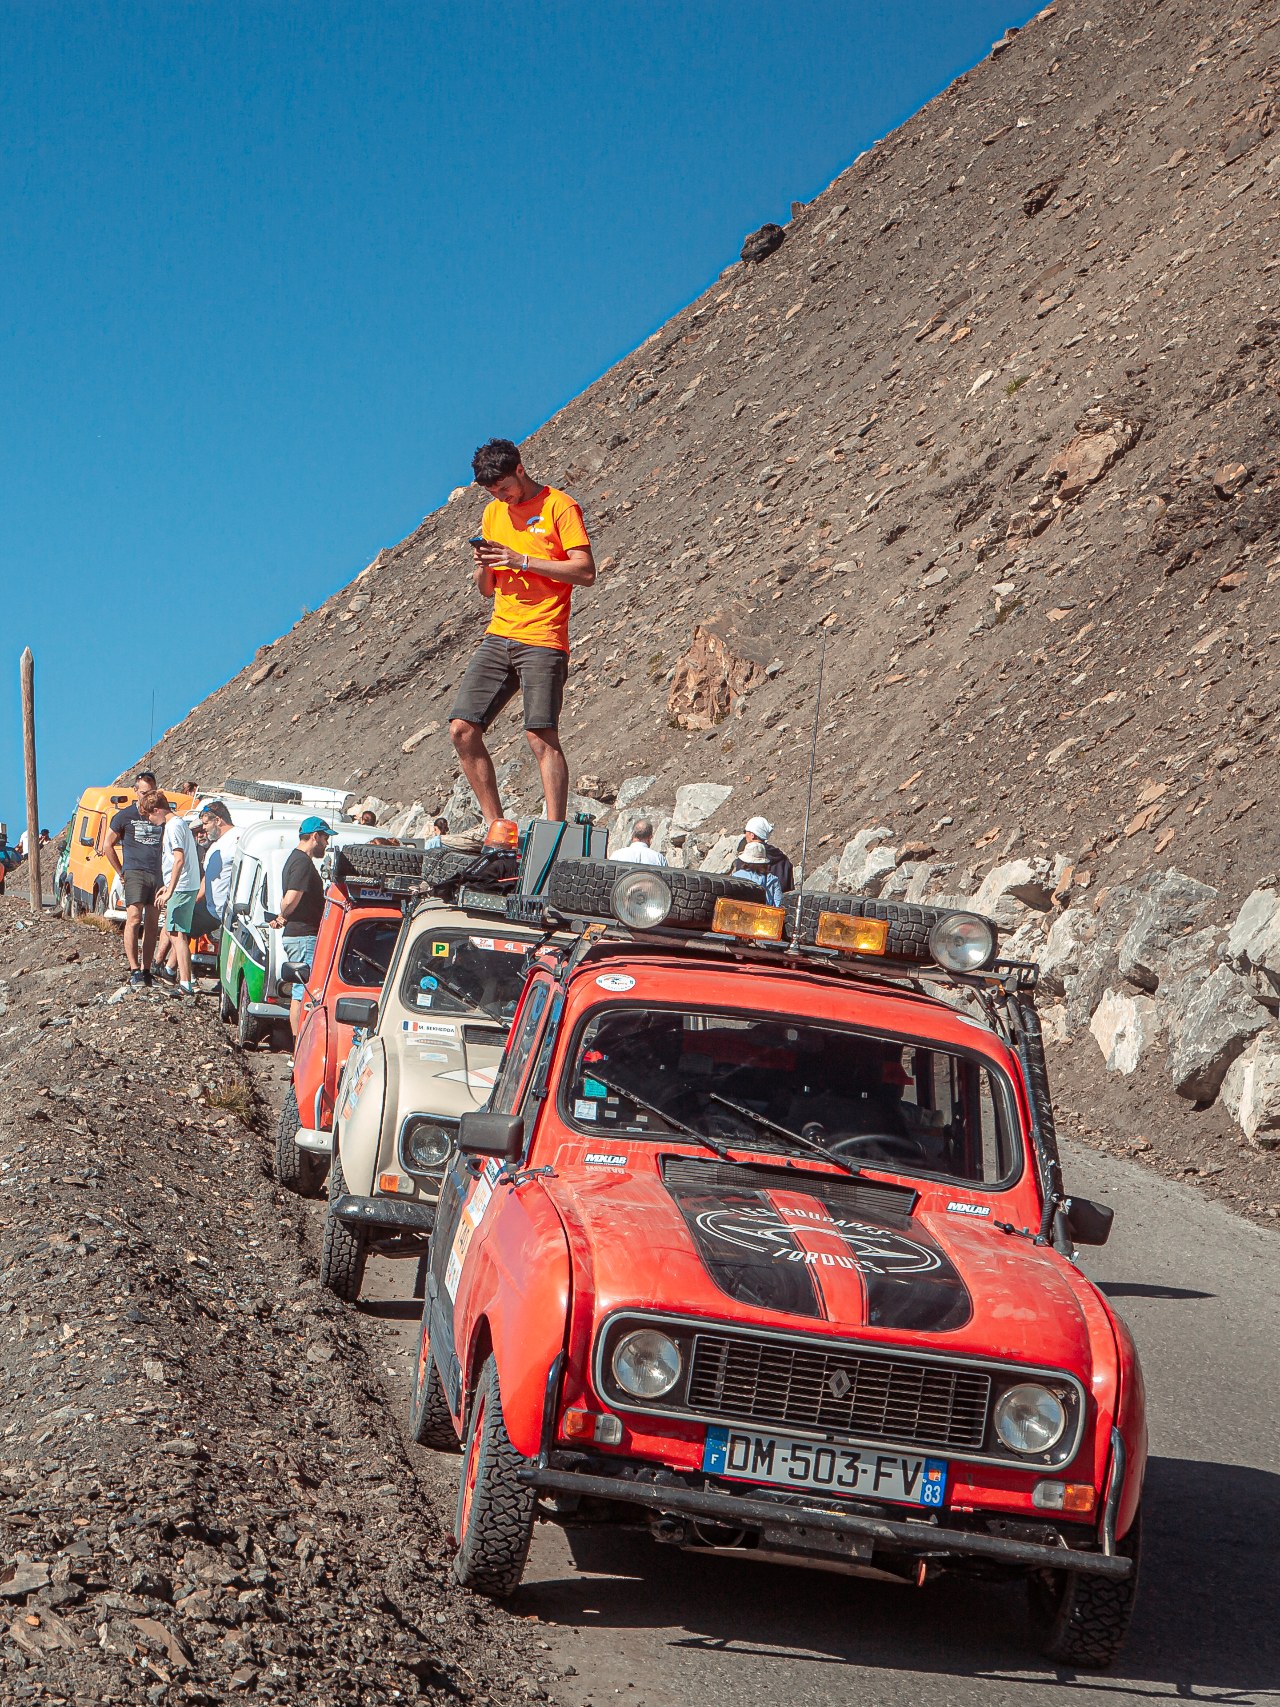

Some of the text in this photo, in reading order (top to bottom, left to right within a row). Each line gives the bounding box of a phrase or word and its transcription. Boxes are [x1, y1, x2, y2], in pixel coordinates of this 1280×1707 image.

[435, 944, 446, 954] P
[778, 1207, 892, 1236] SOUPAPES
[946, 1201, 990, 1216] MXLAB
[772, 1247, 886, 1274] TORDUES
[710, 1453, 719, 1465] F
[923, 1484, 941, 1504] 83
